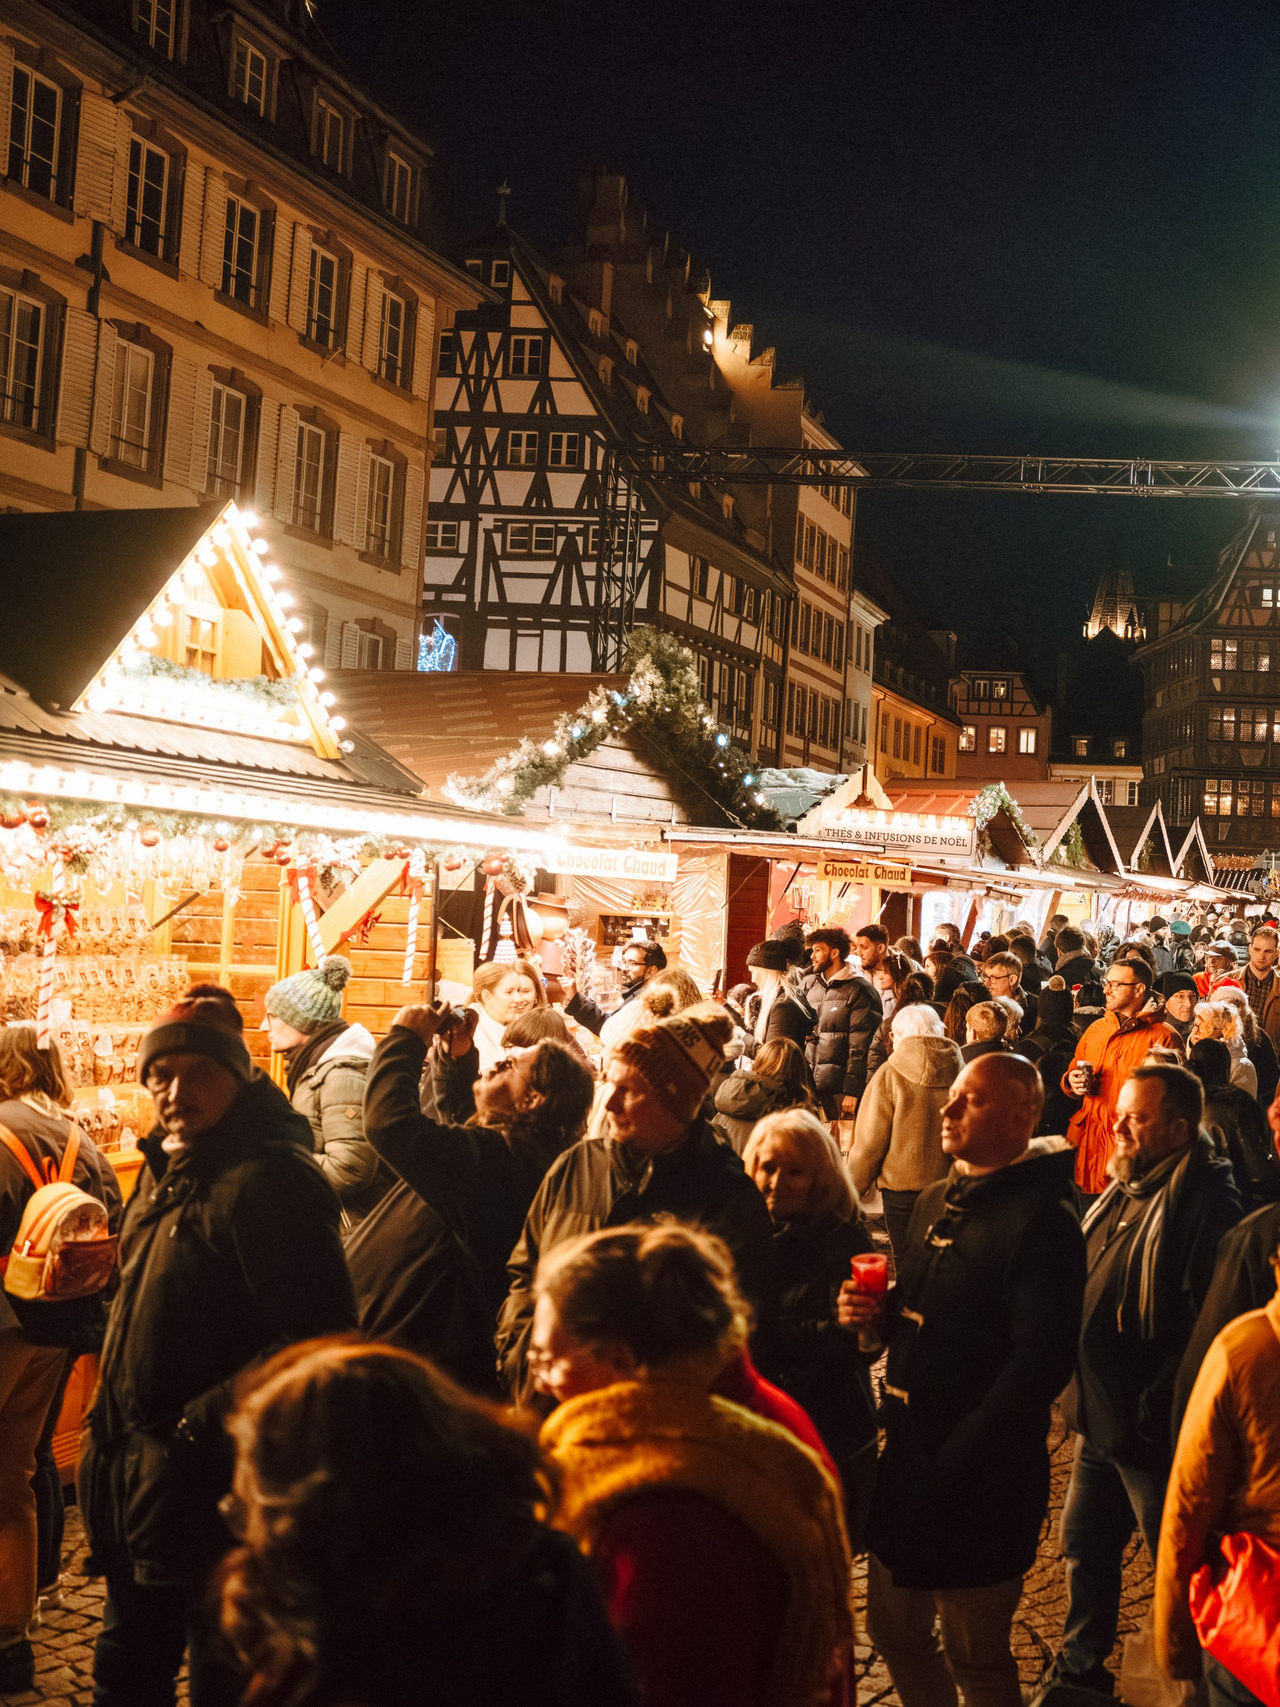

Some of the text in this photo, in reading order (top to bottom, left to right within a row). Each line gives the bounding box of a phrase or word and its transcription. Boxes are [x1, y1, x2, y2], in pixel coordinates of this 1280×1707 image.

[824, 827, 968, 848] THÉS & INFUSIONS DE NOËL
[556, 849, 668, 876] Chocolat Chaud
[823, 863, 907, 881] Chocolat Chaud
